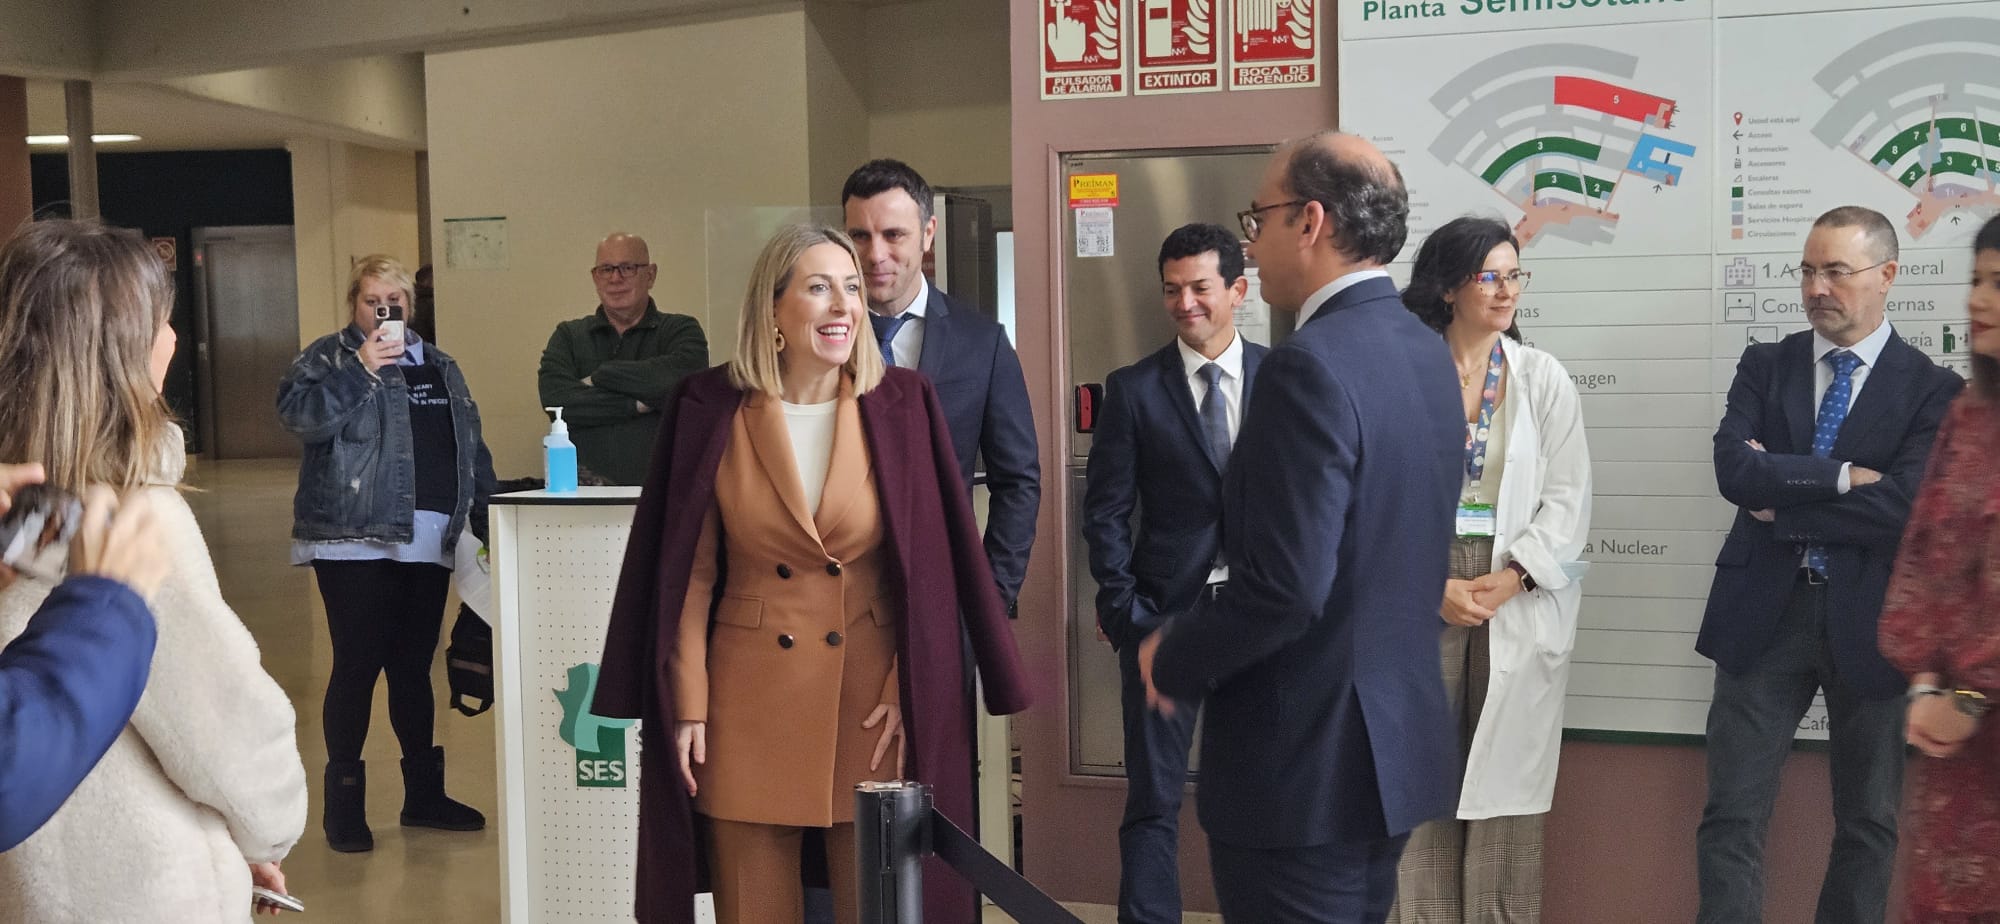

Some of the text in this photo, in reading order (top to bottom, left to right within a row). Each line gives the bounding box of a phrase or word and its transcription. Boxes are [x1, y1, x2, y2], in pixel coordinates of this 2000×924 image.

[1363, 1, 1446, 21] Planta
[1240, 66, 1309, 77] BOCA DE
[1054, 76, 1112, 86] PULSADOR
[1144, 72, 1211, 88] EXTINTOR
[1239, 73, 1310, 85] INCENDIO
[1069, 84, 1114, 93] ALARMA
[1613, 96, 1620, 104] 5
[1960, 123, 1967, 132] 6
[1914, 132, 1920, 140] 7
[1538, 142, 1543, 150] 3
[1892, 146, 1898, 154] 8
[1946, 157, 1953, 165] 3
[1971, 160, 1978, 168] 4
[1551, 175, 1557, 183] 3
[1909, 171, 1916, 180] 2
[1594, 184, 1600, 192] 2
[1899, 259, 1944, 275] neral
[1886, 299, 1935, 312] ernas
[1601, 540, 1668, 555] Nuclear
[579, 760, 624, 781] SES
